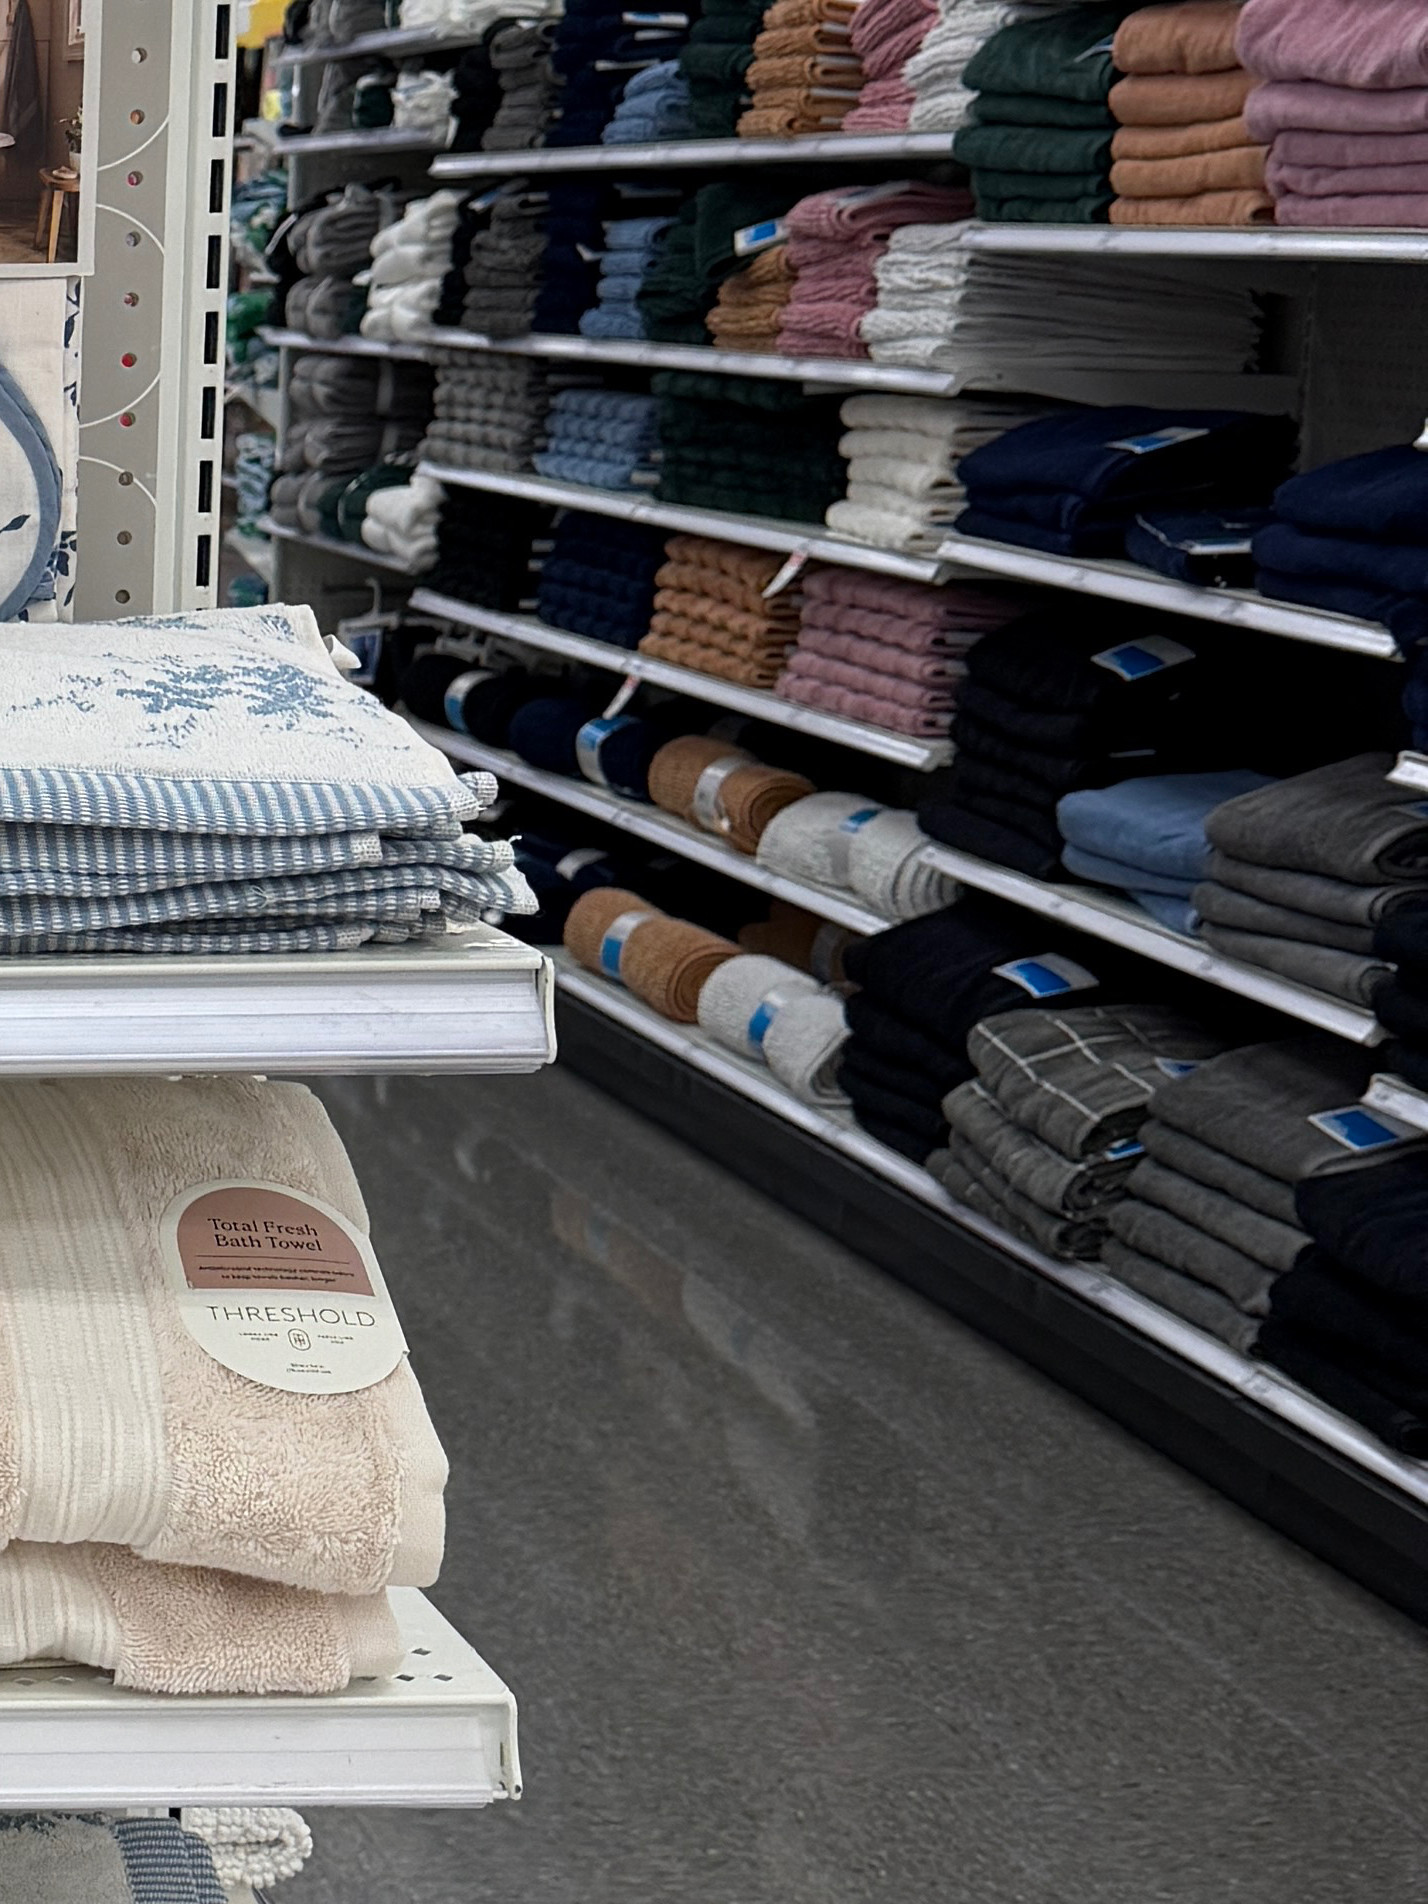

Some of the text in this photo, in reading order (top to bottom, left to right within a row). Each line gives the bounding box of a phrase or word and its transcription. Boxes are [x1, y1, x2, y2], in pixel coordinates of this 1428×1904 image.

[208, 1218, 318, 1237] Total Fresh
[215, 1234, 322, 1252] Bath Towel
[206, 1305, 375, 1327] THRESHOLD
